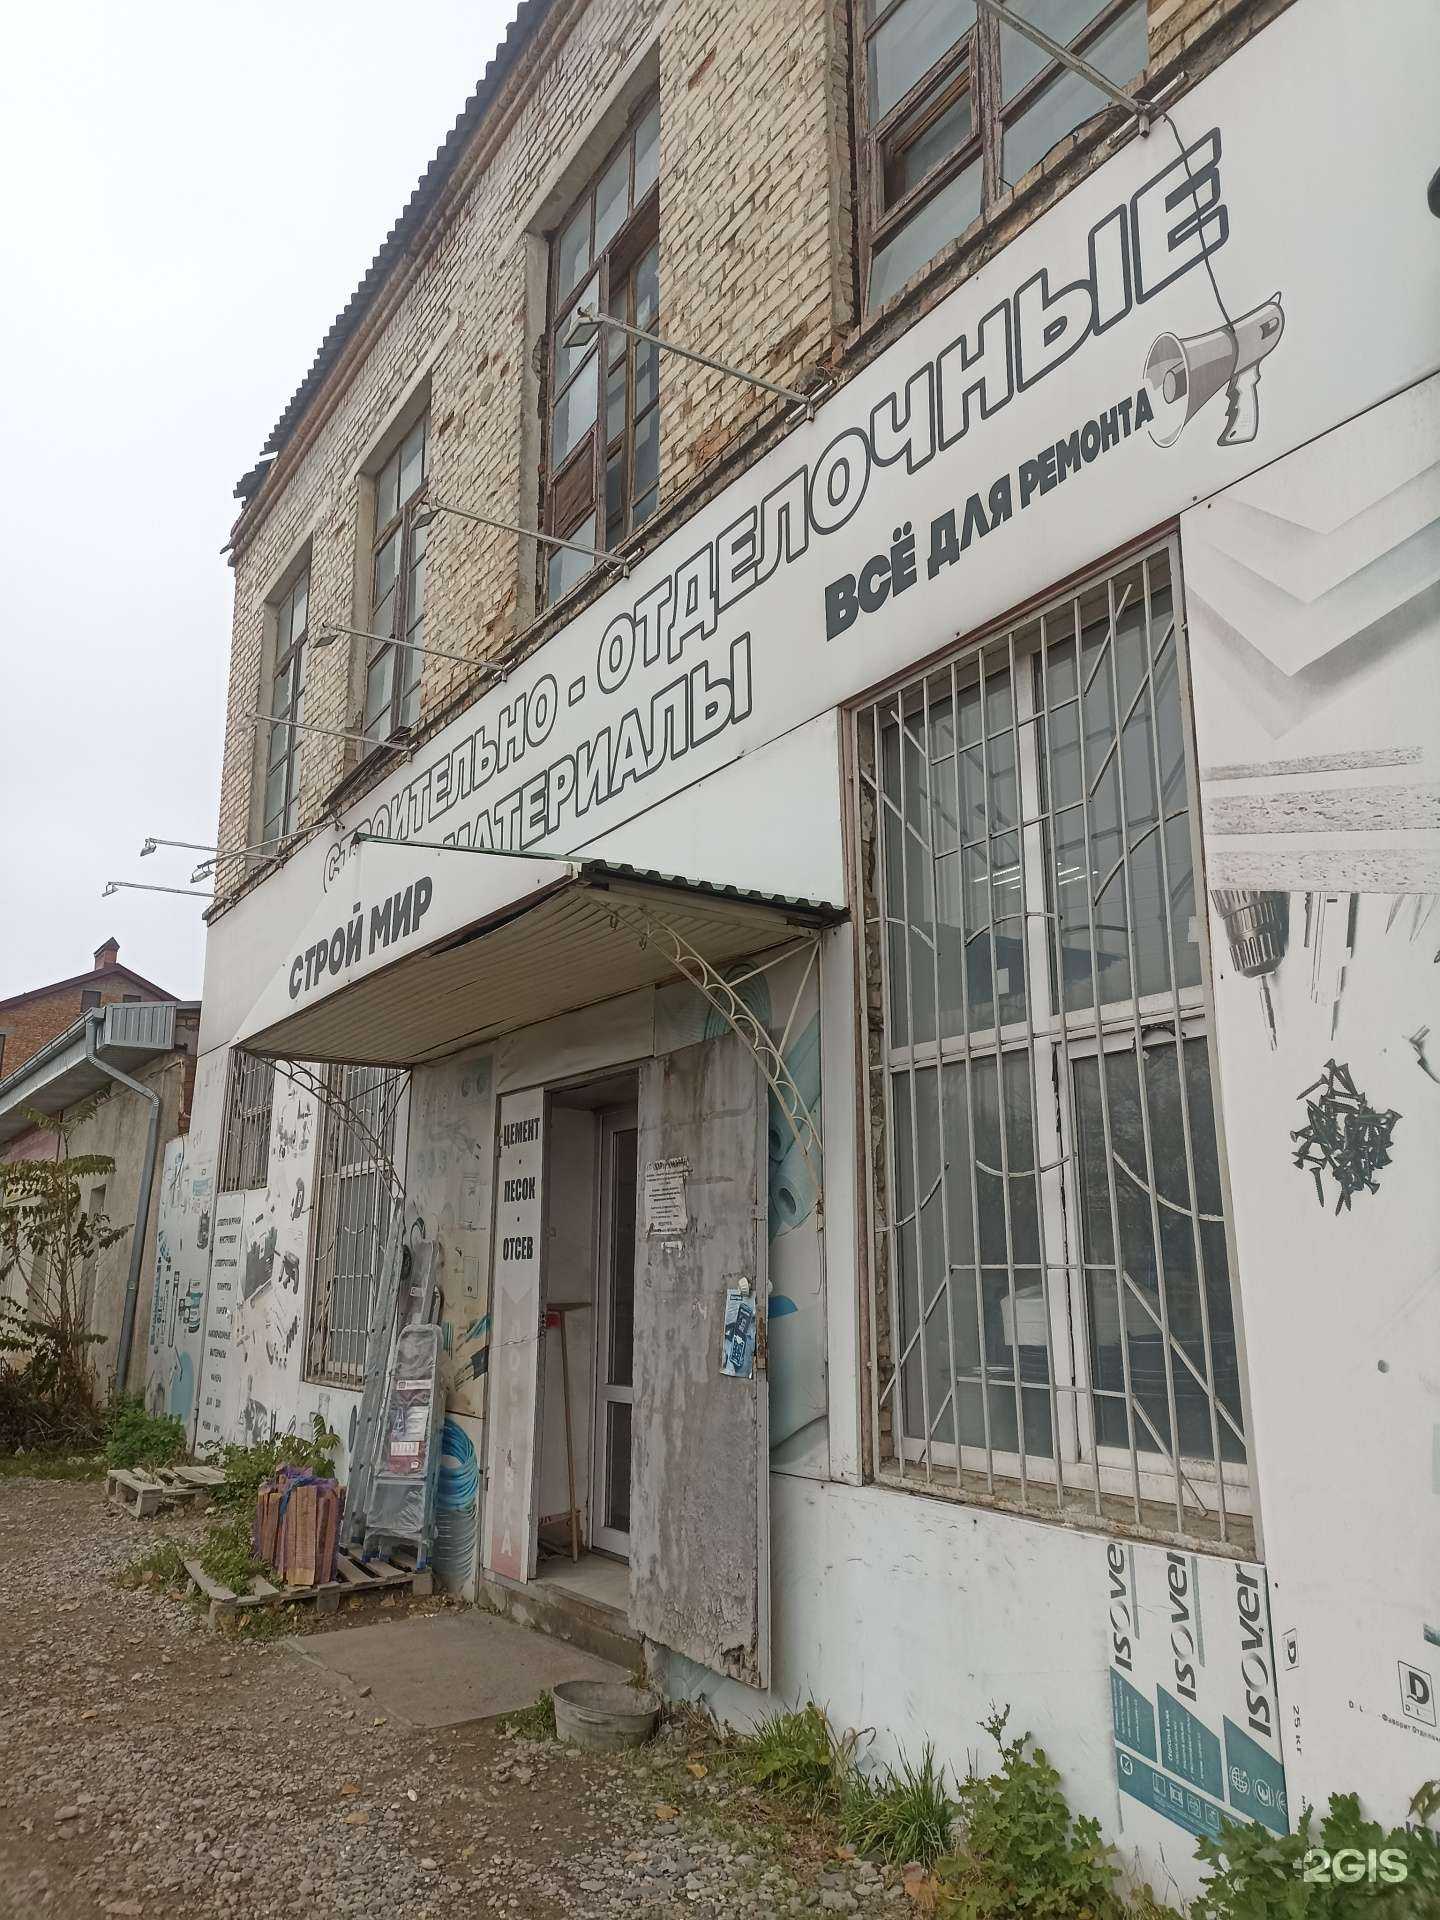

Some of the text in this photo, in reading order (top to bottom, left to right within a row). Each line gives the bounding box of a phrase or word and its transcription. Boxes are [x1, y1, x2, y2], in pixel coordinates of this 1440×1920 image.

[597, 127, 1229, 695] ОТДЕЛОЧНЫЕ
[826, 389, 1155, 641] ВСЁ ДЛЯ РЕМОНТА
[289, 876, 433, 1000] СТРОЙ МИР
[502, 1117, 541, 1149] ЦЕМЕНТ
[503, 1176, 536, 1203] ПЕСОК
[502, 1236, 534, 1261] ОТСЕВ
[1293, 1705, 1301, 1729] 25
